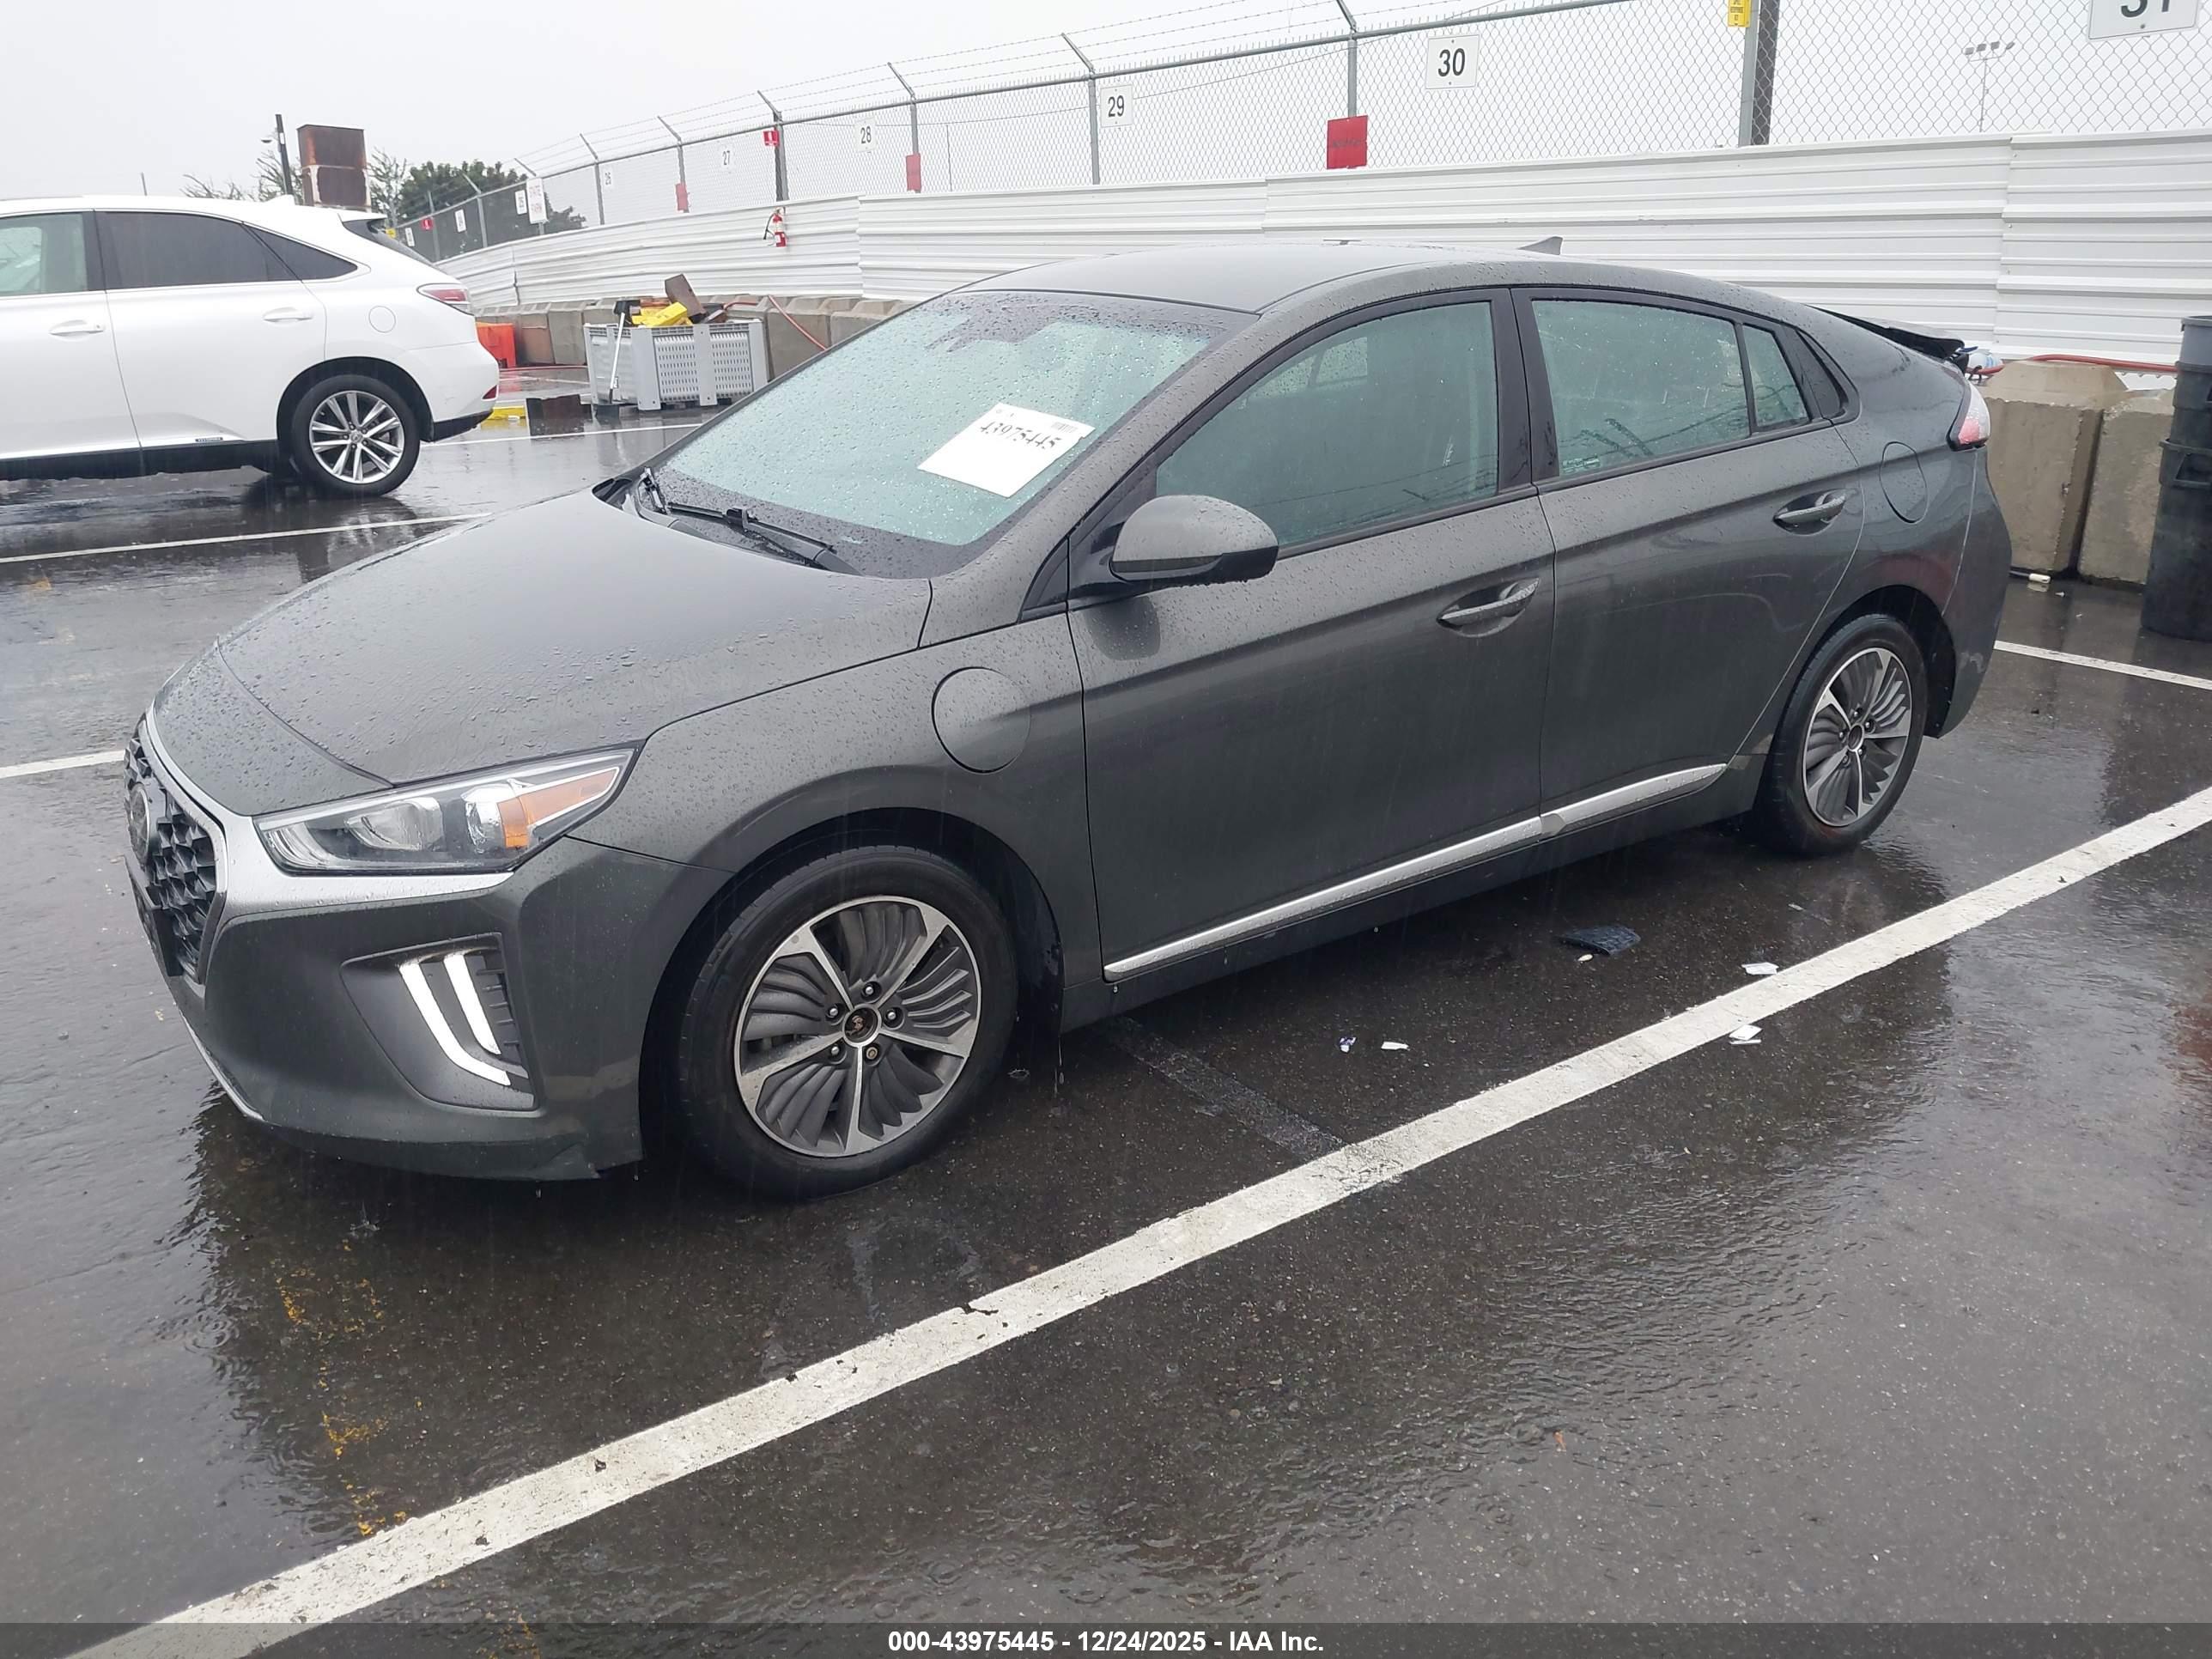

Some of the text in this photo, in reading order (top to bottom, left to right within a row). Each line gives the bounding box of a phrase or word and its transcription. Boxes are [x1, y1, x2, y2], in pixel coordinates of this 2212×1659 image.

[1437, 47, 1466, 77] 30
[1108, 94, 1125, 118] 29
[860, 125, 872, 144] 28
[722, 150, 731, 166] 27
